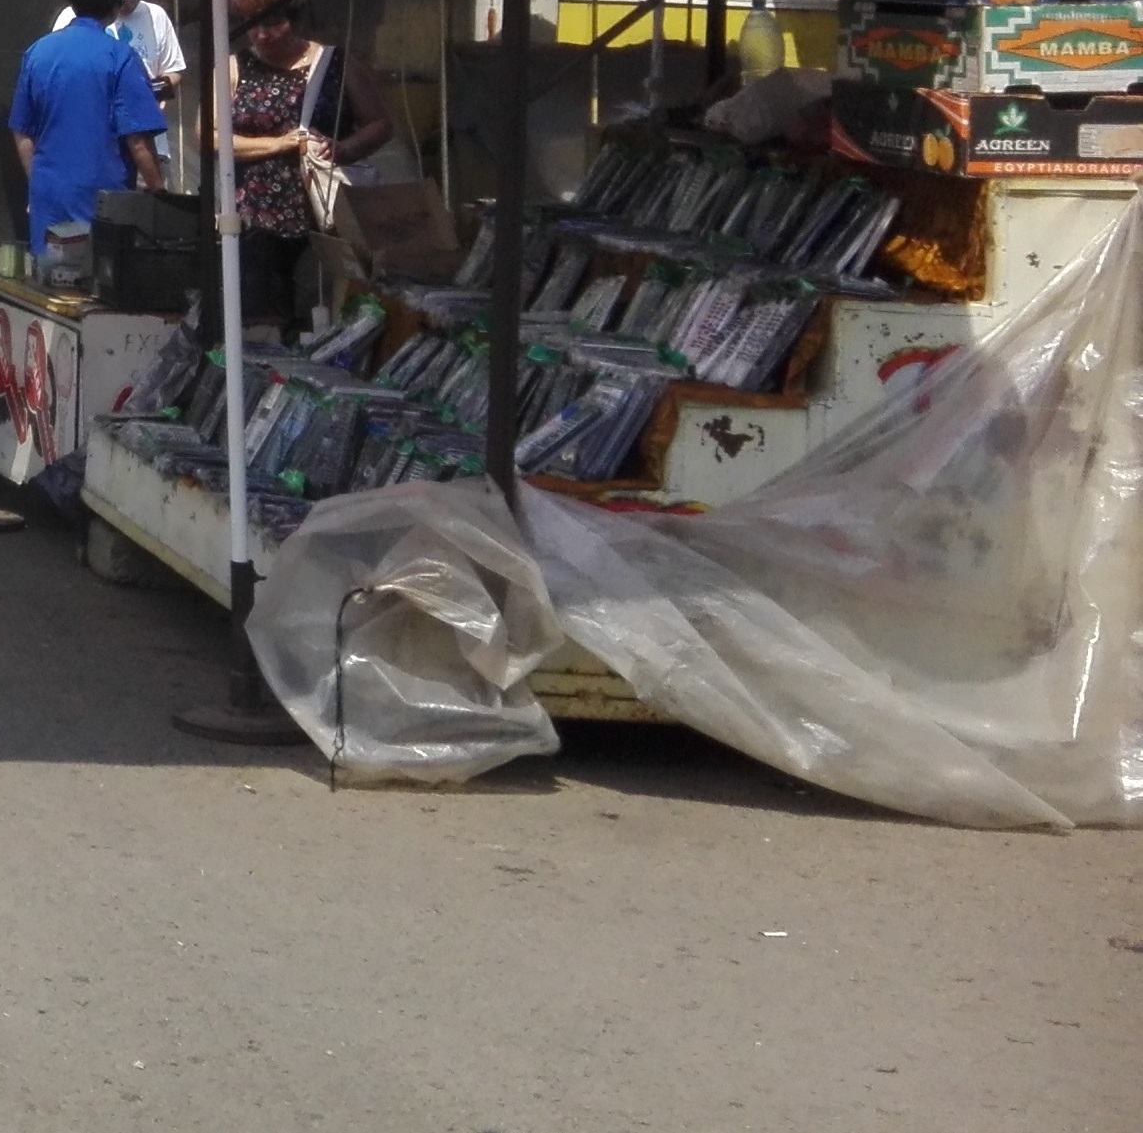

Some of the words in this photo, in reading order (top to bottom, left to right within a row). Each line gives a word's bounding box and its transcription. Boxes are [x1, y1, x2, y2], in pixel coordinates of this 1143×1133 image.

[1040, 41, 1129, 56] MAMBA
[974, 139, 1050, 150] AGREEN
[993, 162, 1073, 172] EGYPTIAN
